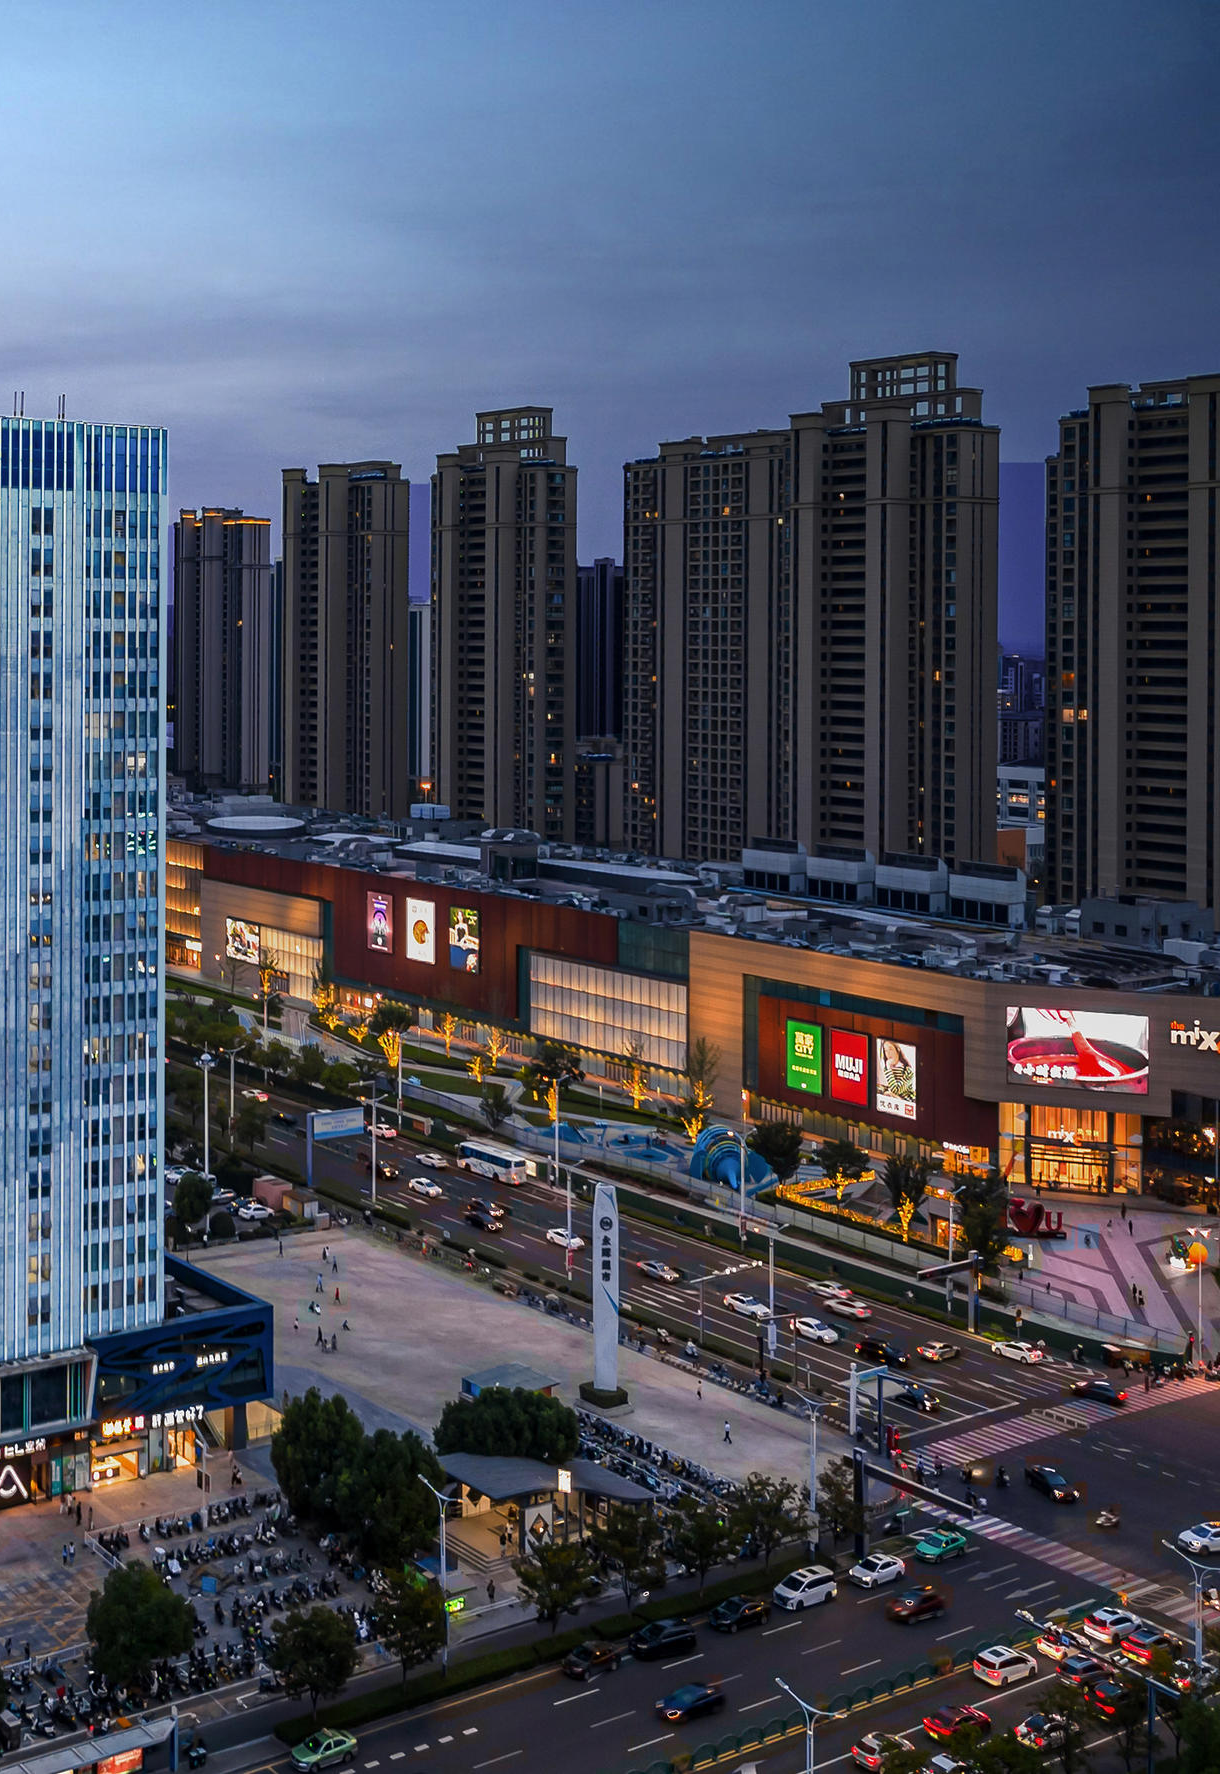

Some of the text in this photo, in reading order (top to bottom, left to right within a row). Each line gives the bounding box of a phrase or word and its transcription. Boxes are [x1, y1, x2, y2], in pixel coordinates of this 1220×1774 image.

[1170, 1020, 1185, 1030] the
[1170, 1019, 1220, 1054] mix
[835, 1053, 863, 1075] MUJI
